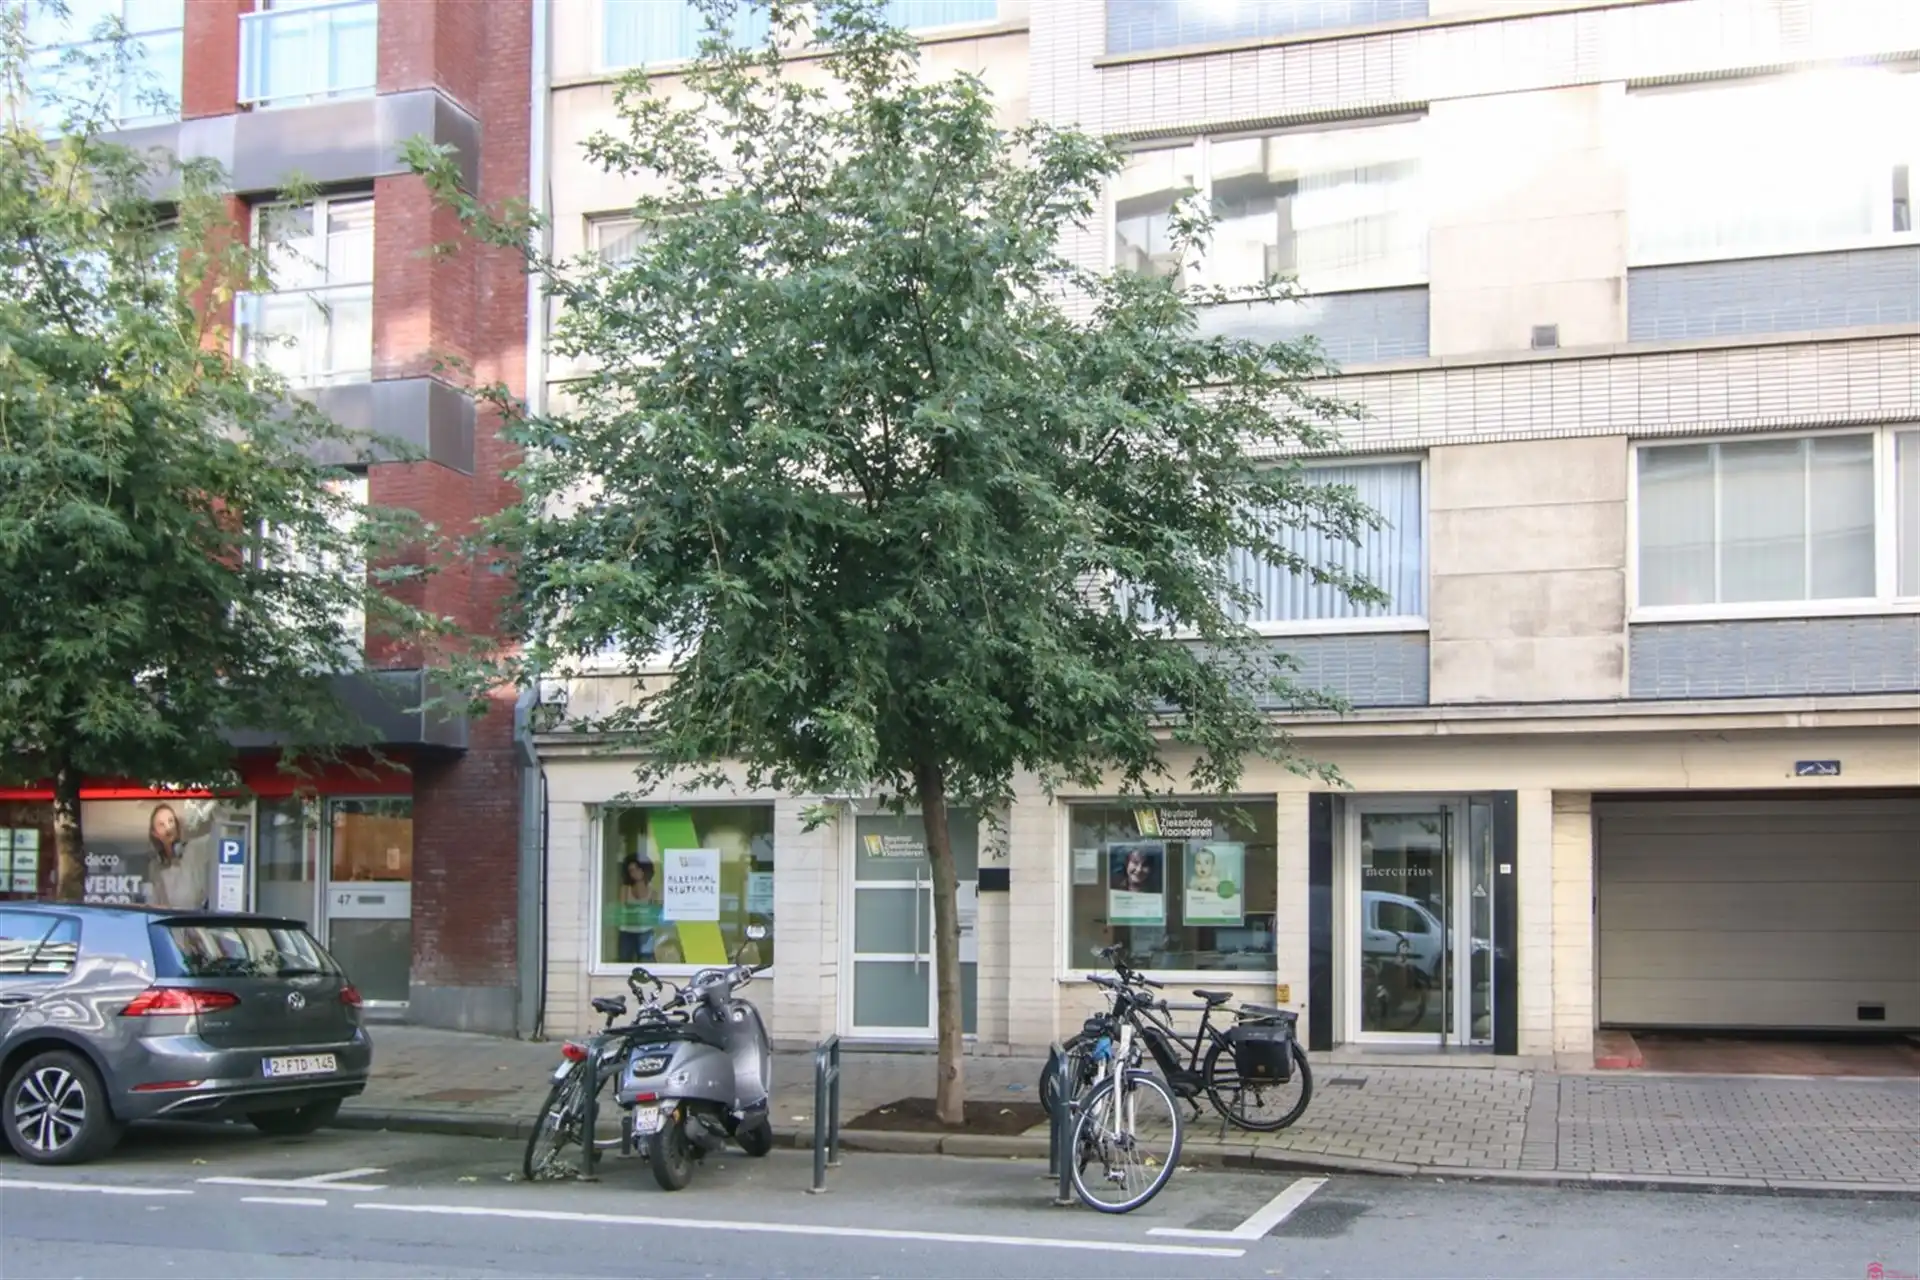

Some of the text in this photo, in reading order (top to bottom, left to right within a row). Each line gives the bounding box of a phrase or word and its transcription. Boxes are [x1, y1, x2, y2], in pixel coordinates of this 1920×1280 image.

[1160, 817, 1212, 828] Ziekenfonds
[224, 841, 239, 862] P
[1366, 864, 1433, 877] mercurius
[338, 894, 351, 905] 47
